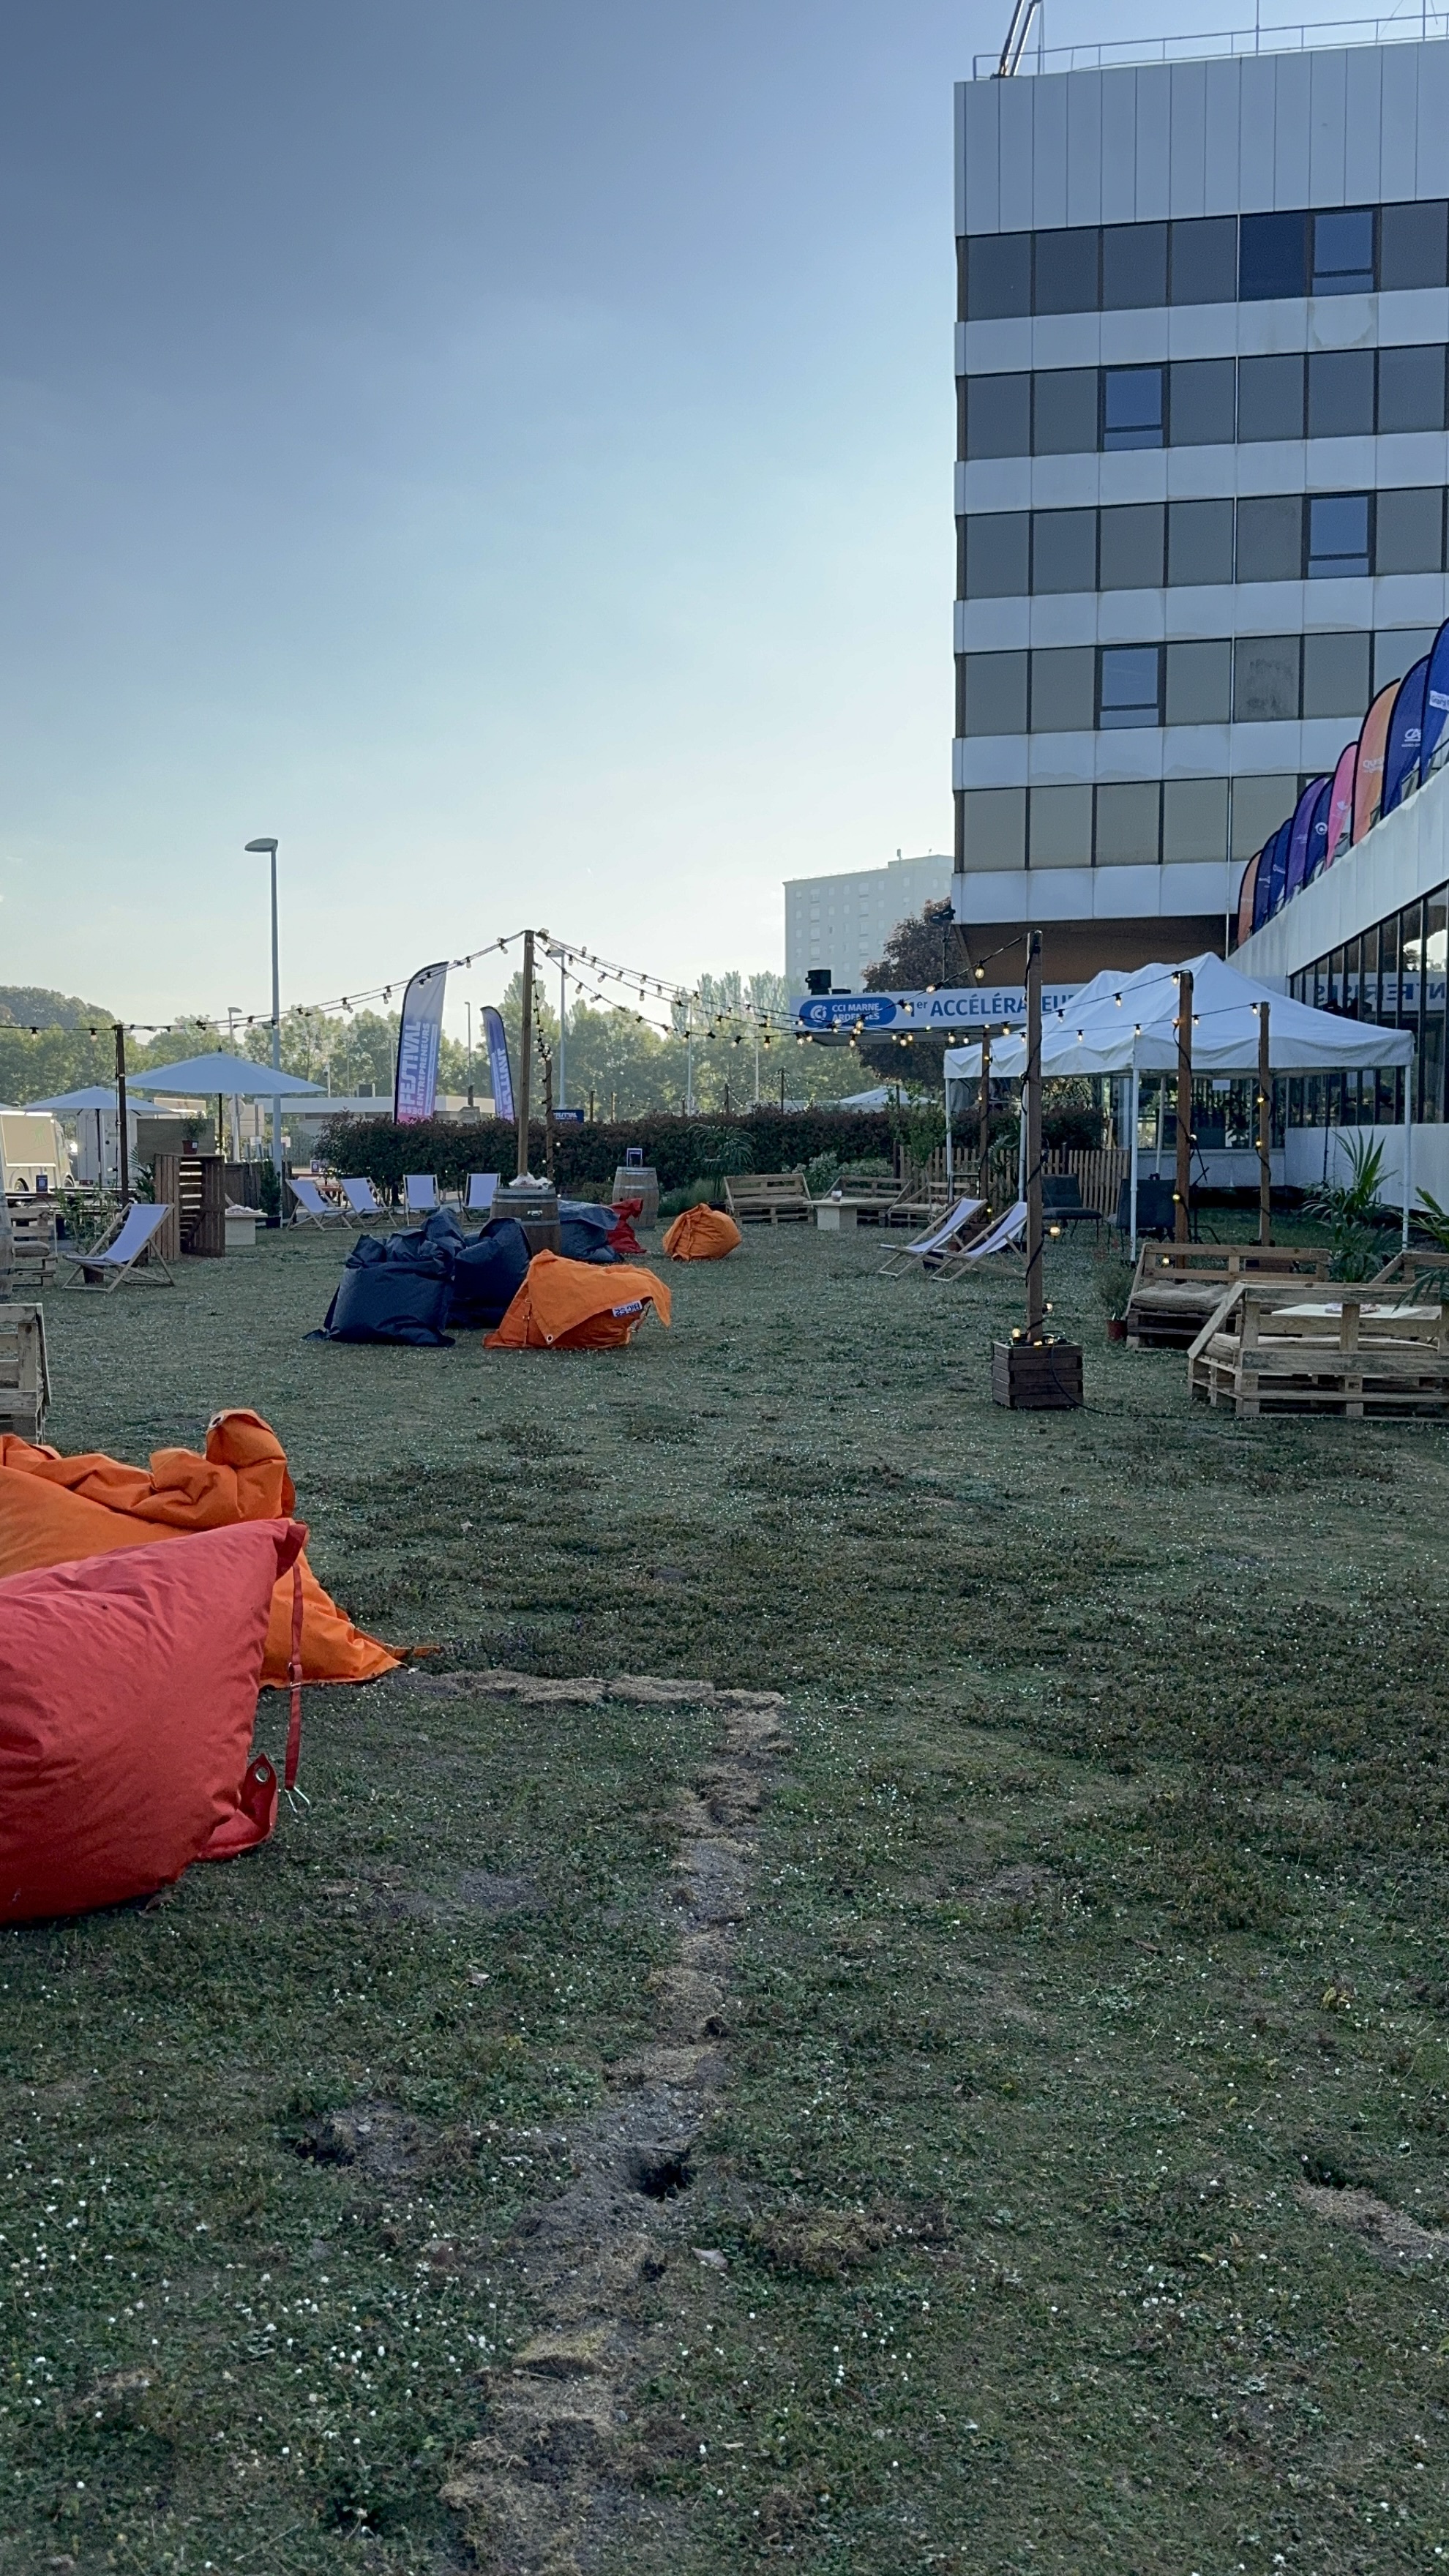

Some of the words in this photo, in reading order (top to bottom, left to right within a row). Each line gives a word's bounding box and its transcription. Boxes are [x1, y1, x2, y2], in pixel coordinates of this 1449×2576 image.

[831, 1004, 846, 1012] CCI
[847, 1003, 880, 1011] MARNE
[930, 992, 1074, 1017] ACCÉLÉRAEU
[416, 1022, 430, 1107] ENTREPRENEURS
